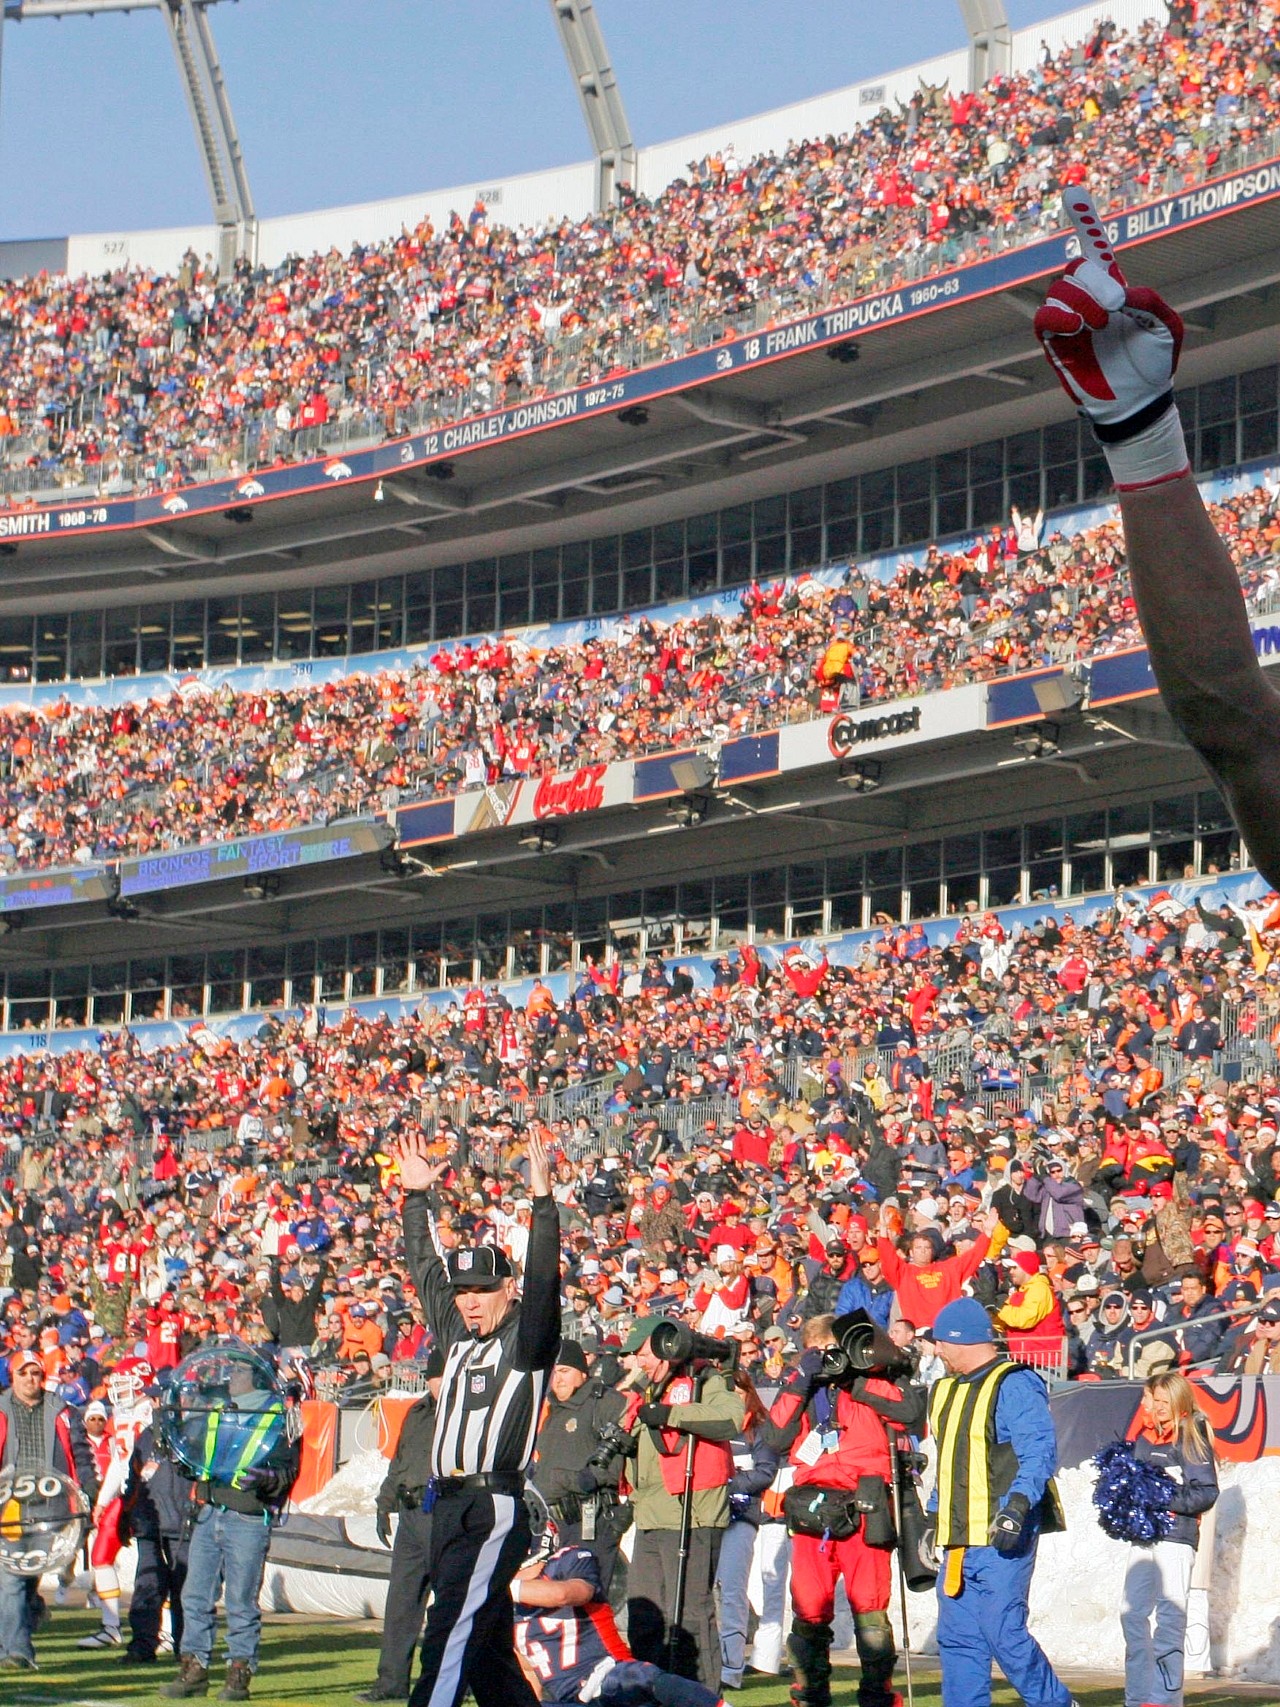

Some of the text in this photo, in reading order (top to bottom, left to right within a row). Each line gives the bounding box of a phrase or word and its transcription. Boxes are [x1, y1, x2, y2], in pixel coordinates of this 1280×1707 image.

[1127, 202, 1175, 238] BILLY
[743, 278, 959, 361] 18 FRANK TRIPUCKA 1960-63
[424, 383, 625, 455] 12 CHARLEY JOHNSON 1972-75
[0, 513, 50, 537] SMITH
[830, 706, 921, 753] Comcast
[138, 836, 286, 878] BRONCOS FANTASY
